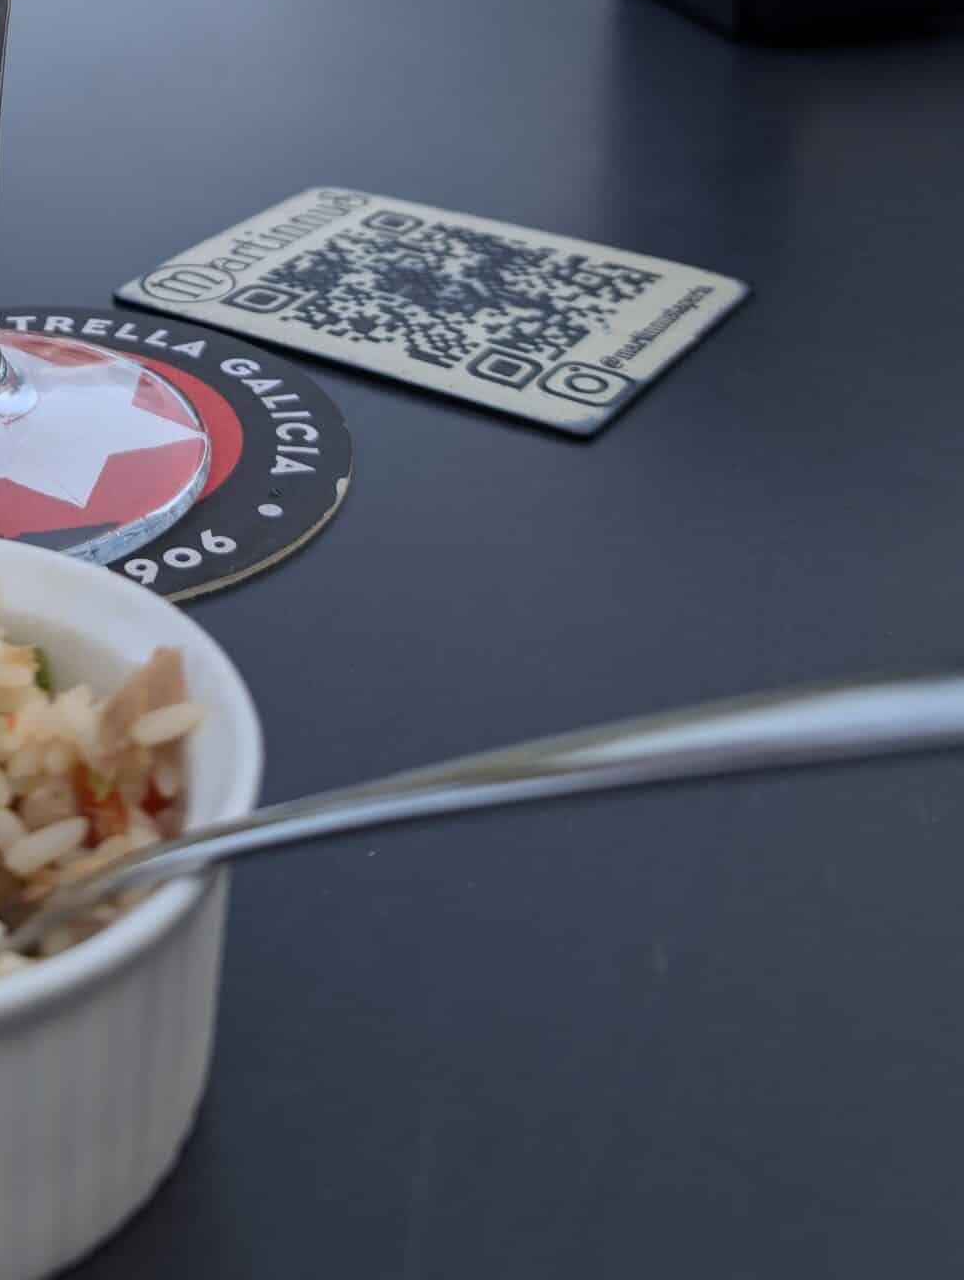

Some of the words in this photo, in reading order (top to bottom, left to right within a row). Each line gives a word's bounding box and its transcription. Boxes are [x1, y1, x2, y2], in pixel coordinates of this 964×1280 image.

[4, 314, 208, 359] TRELLA
[219, 357, 322, 476] GALICIA
[122, 528, 238, 585] 906
